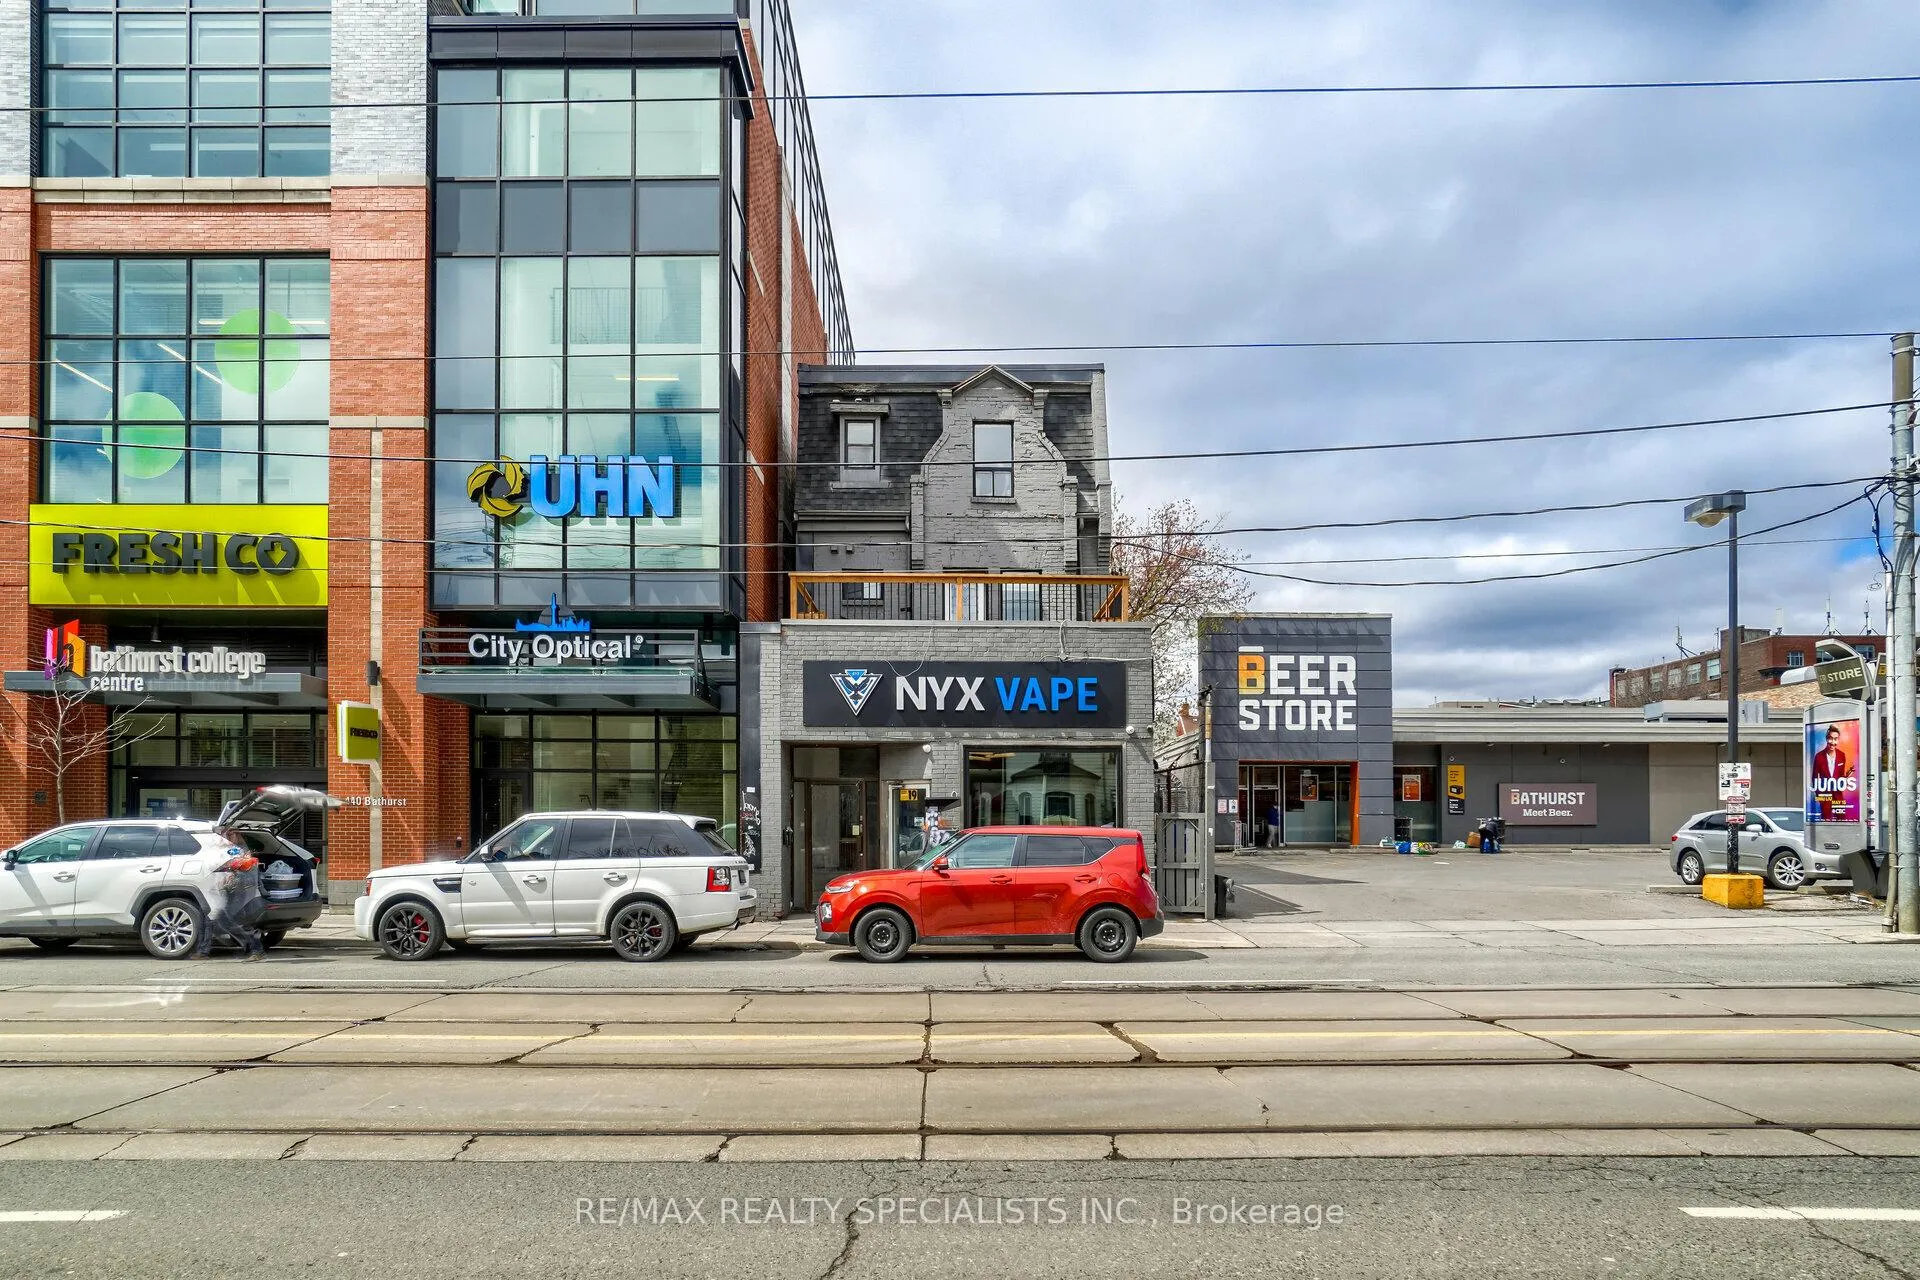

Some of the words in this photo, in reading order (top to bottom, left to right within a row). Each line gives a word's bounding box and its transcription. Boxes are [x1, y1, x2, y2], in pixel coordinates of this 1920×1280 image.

[530, 455, 675, 517] UHN
[468, 634, 523, 663] City
[90, 646, 186, 673] bathurst
[187, 646, 266, 679] college
[1238, 650, 1357, 695] BEER
[1828, 667, 1863, 682] STORE
[90, 672, 144, 692] centre
[896, 676, 985, 711] NYX
[995, 677, 1098, 711] VAPE
[1239, 699, 1356, 731] STORE
[364, 796, 407, 806] Bathurst
[908, 790, 917, 800] 19
[1511, 791, 1585, 805] BATHURST
[1523, 808, 1548, 817] Meet
[1549, 808, 1573, 817] Beer.
